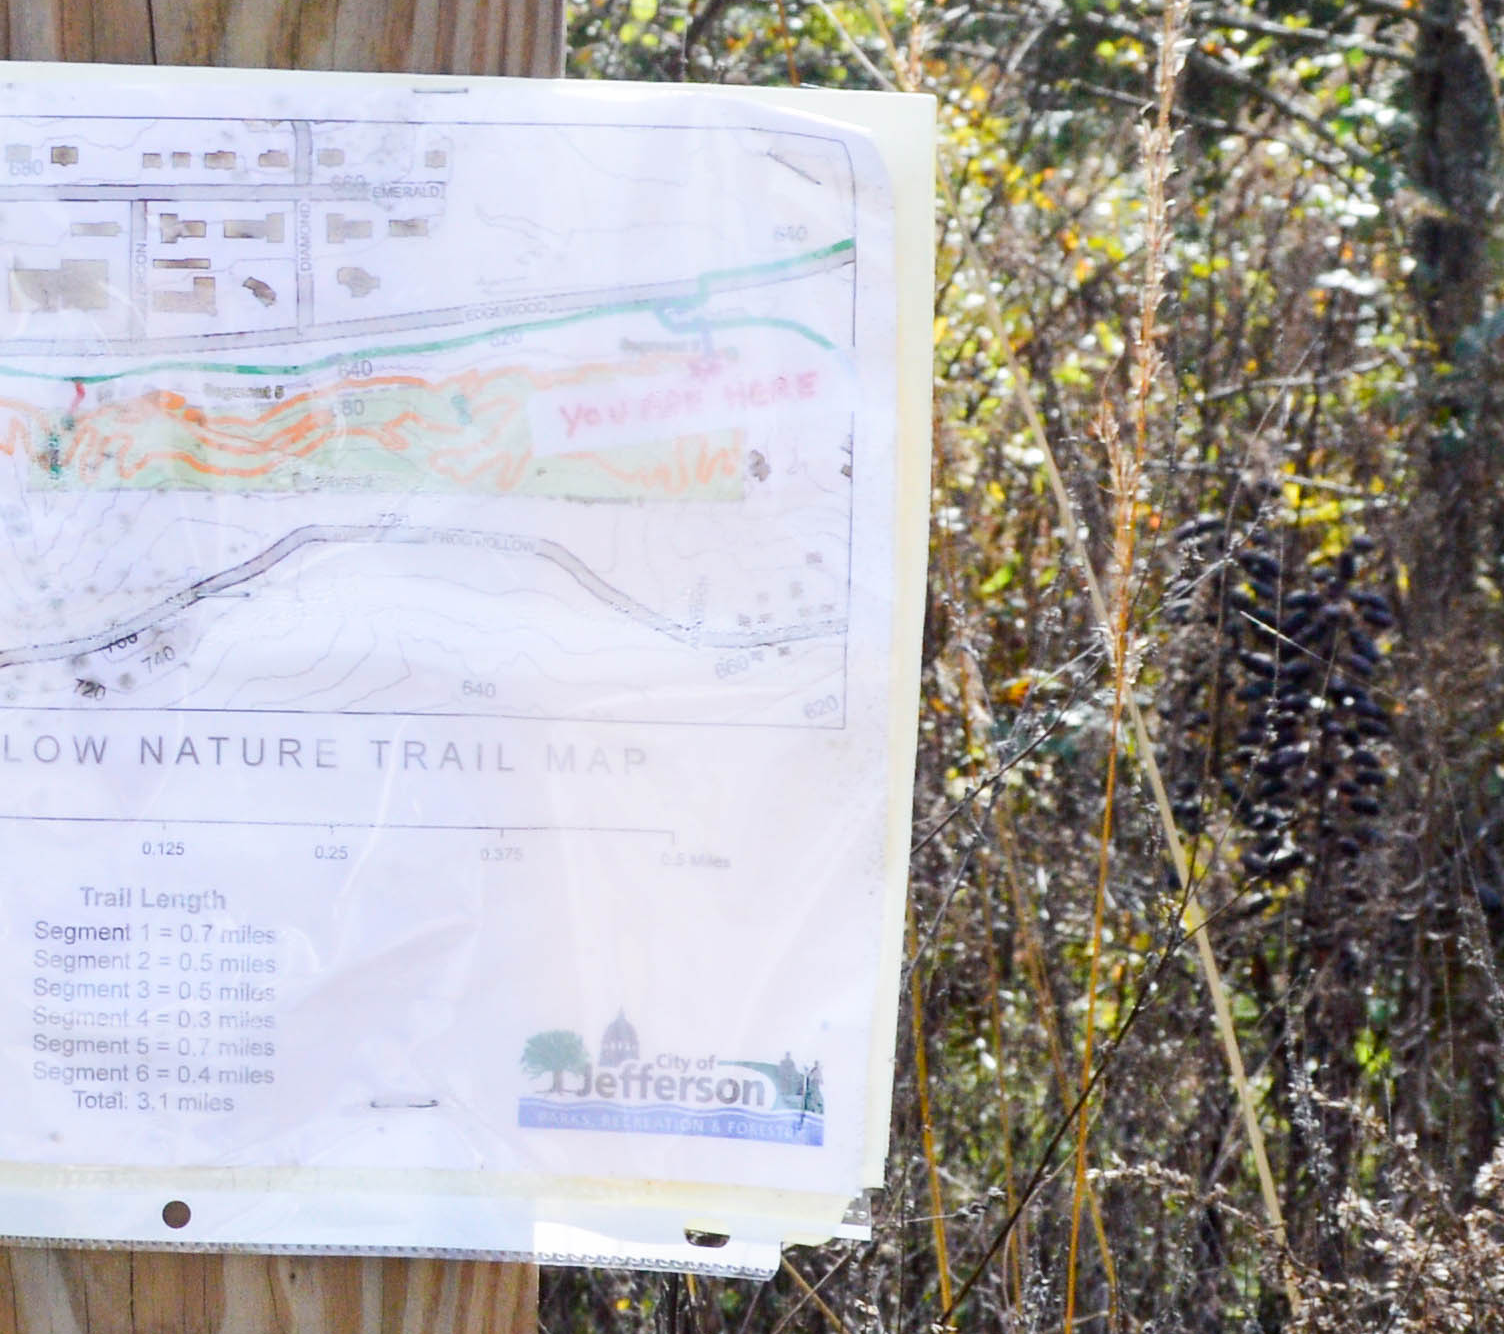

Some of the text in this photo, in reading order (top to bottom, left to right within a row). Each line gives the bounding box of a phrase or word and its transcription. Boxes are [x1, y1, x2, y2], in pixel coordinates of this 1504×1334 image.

[371, 185, 441, 199] EMERALD
[299, 202, 312, 273] DIAMOND
[141, 644, 177, 675] 740
[74, 677, 107, 701] 720
[139, 735, 339, 769] NATURE
[369, 739, 516, 772] TRAIL
[545, 743, 648, 777] MAP
[141, 840, 185, 857] 0.125
[313, 845, 349, 861] 0.25
[479, 846, 524, 862] 0.375
[79, 886, 228, 915] Trail Length
[33, 920, 132, 945] Segment
[142, 924, 151, 942] 1
[179, 923, 214, 944] 0.7
[219, 925, 277, 945] miles
[32, 949, 131, 973] Segment
[137, 951, 152, 971] 2
[178, 952, 214, 972] 0.5
[219, 954, 277, 974] miles
[32, 977, 130, 1001] Segment
[137, 980, 151, 999] 3
[178, 981, 213, 1000] 0.5
[219, 982, 276, 1002] miles
[32, 1033, 129, 1058] Segment
[136, 1036, 150, 1055] 5
[177, 1037, 209, 1056] 0.7
[218, 1038, 275, 1058] miles
[32, 1061, 129, 1085] Segment
[136, 1064, 150, 1083] 6
[177, 1064, 211, 1084] 0.4
[218, 1065, 275, 1085] miles
[656, 1052, 718, 1071] City of
[576, 1062, 766, 1107] Jefferson
[72, 1089, 235, 1113] Total: 3.1 miles
